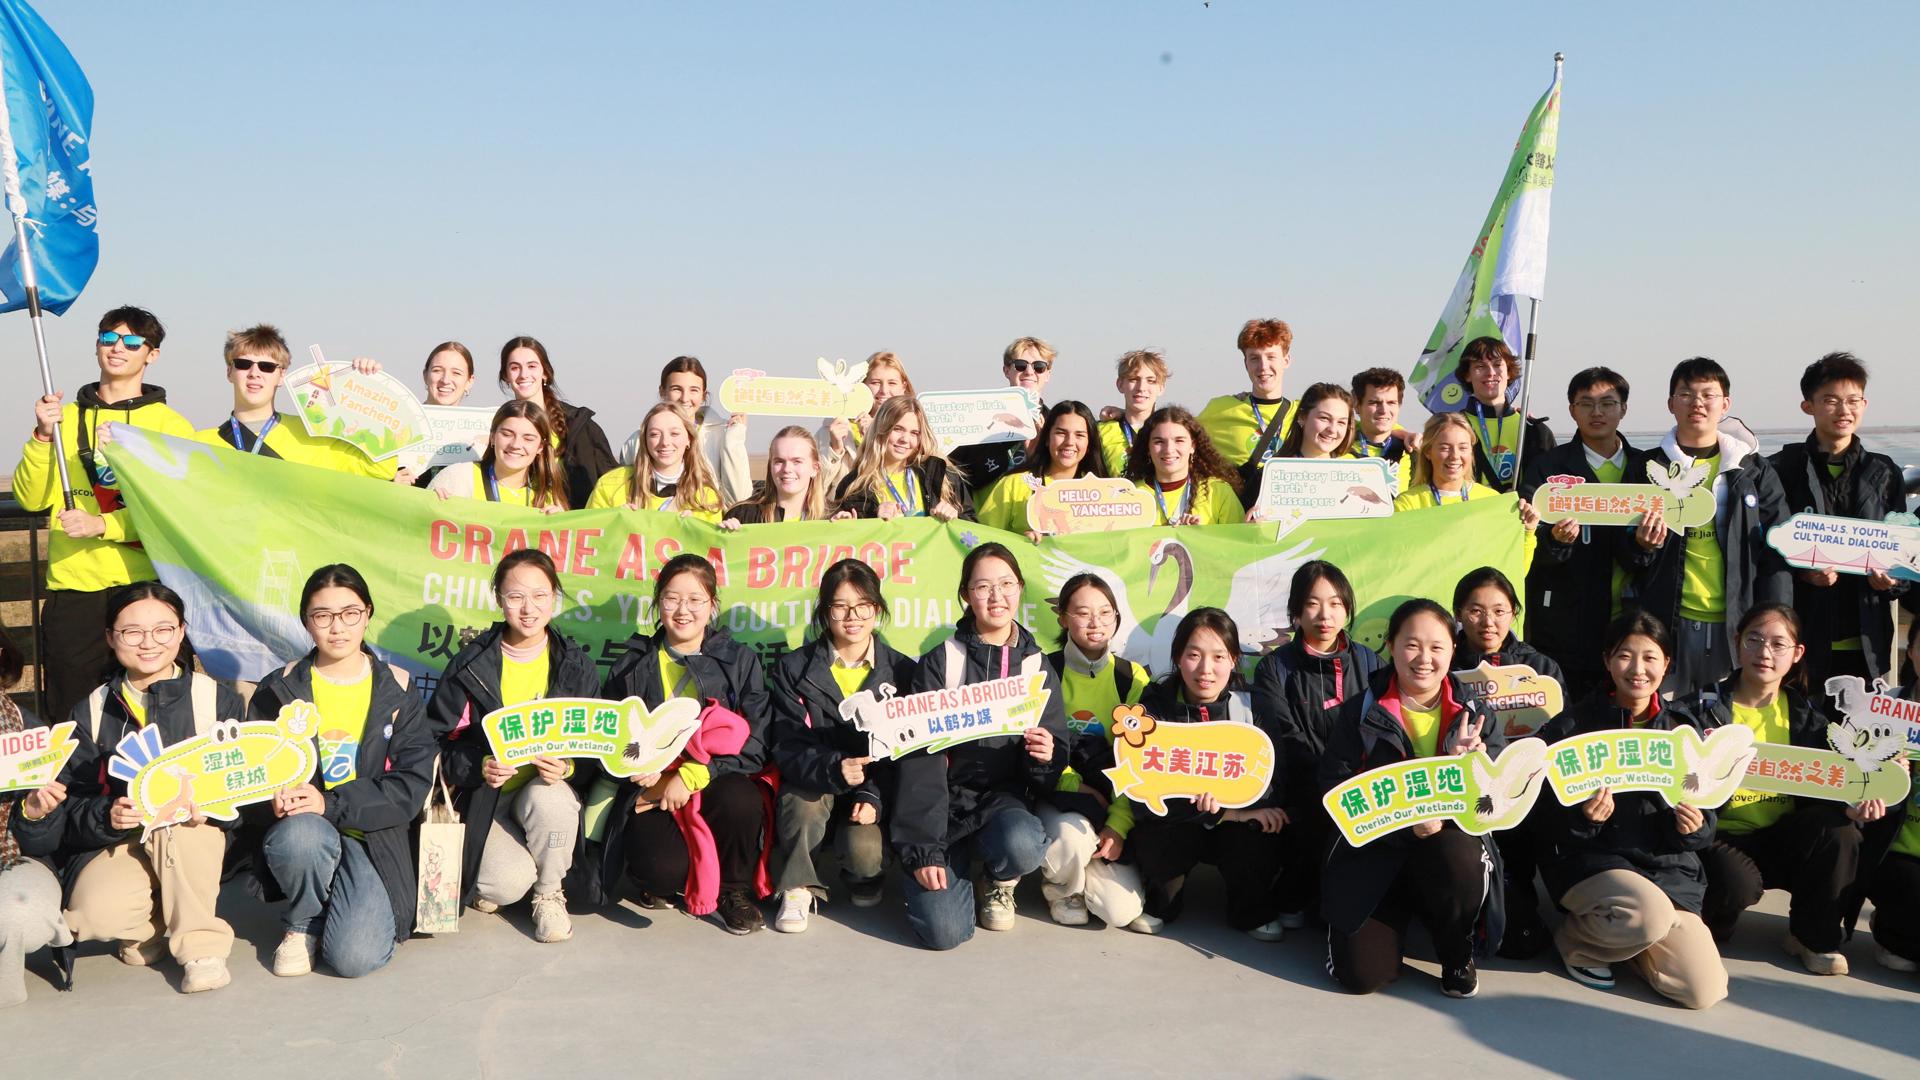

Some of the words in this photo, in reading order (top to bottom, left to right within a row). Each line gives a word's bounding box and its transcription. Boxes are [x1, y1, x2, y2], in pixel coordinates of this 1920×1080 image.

[344, 377, 399, 412] Amazing
[733, 388, 833, 408] 邂逅自然之美
[339, 393, 401, 430] Yancheng
[932, 423, 984, 435] essengers
[1271, 469, 1328, 483] Migratory
[1331, 470, 1363, 484] Birds,
[1059, 489, 1100, 502] HELLO
[1271, 494, 1336, 508] Messengers
[1548, 494, 1664, 515] 邂逅自然之美
[1071, 502, 1141, 517] YANCHENG
[1793, 531, 1845, 545] CULTURAL
[1847, 537, 1900, 551] DIALOGUE
[1794, 520, 1848, 535] CHINA-U.S.
[1852, 526, 1889, 539] YOUTH
[430, 519, 604, 577] CRANE
[705, 546, 729, 588] A
[895, 598, 1038, 633] DIALE
[886, 694, 936, 720] CRANE
[939, 690, 958, 709] AS
[962, 687, 971, 706] A
[975, 677, 1027, 704] BRIDGE
[499, 708, 618, 742] 保护湿地
[928, 708, 992, 734] 以鹤为媒
[2, 731, 47, 756] IDGE
[506, 744, 543, 759] Cherish
[546, 742, 565, 751] Our
[568, 741, 614, 753] Wetlands
[203, 748, 245, 772] 湿地
[1143, 747, 1246, 779] 大美江苏
[1555, 739, 1673, 777] 保护湿地
[226, 766, 266, 791] 绿城
[1566, 778, 1602, 794] Cherish
[1605, 776, 1622, 785] Our
[1625, 773, 1672, 785] Wetlands
[1341, 766, 1464, 818] 保护湿地
[1355, 815, 1392, 836] Cherish
[1394, 809, 1413, 820] Our
[1416, 802, 1465, 815] Wetlands
